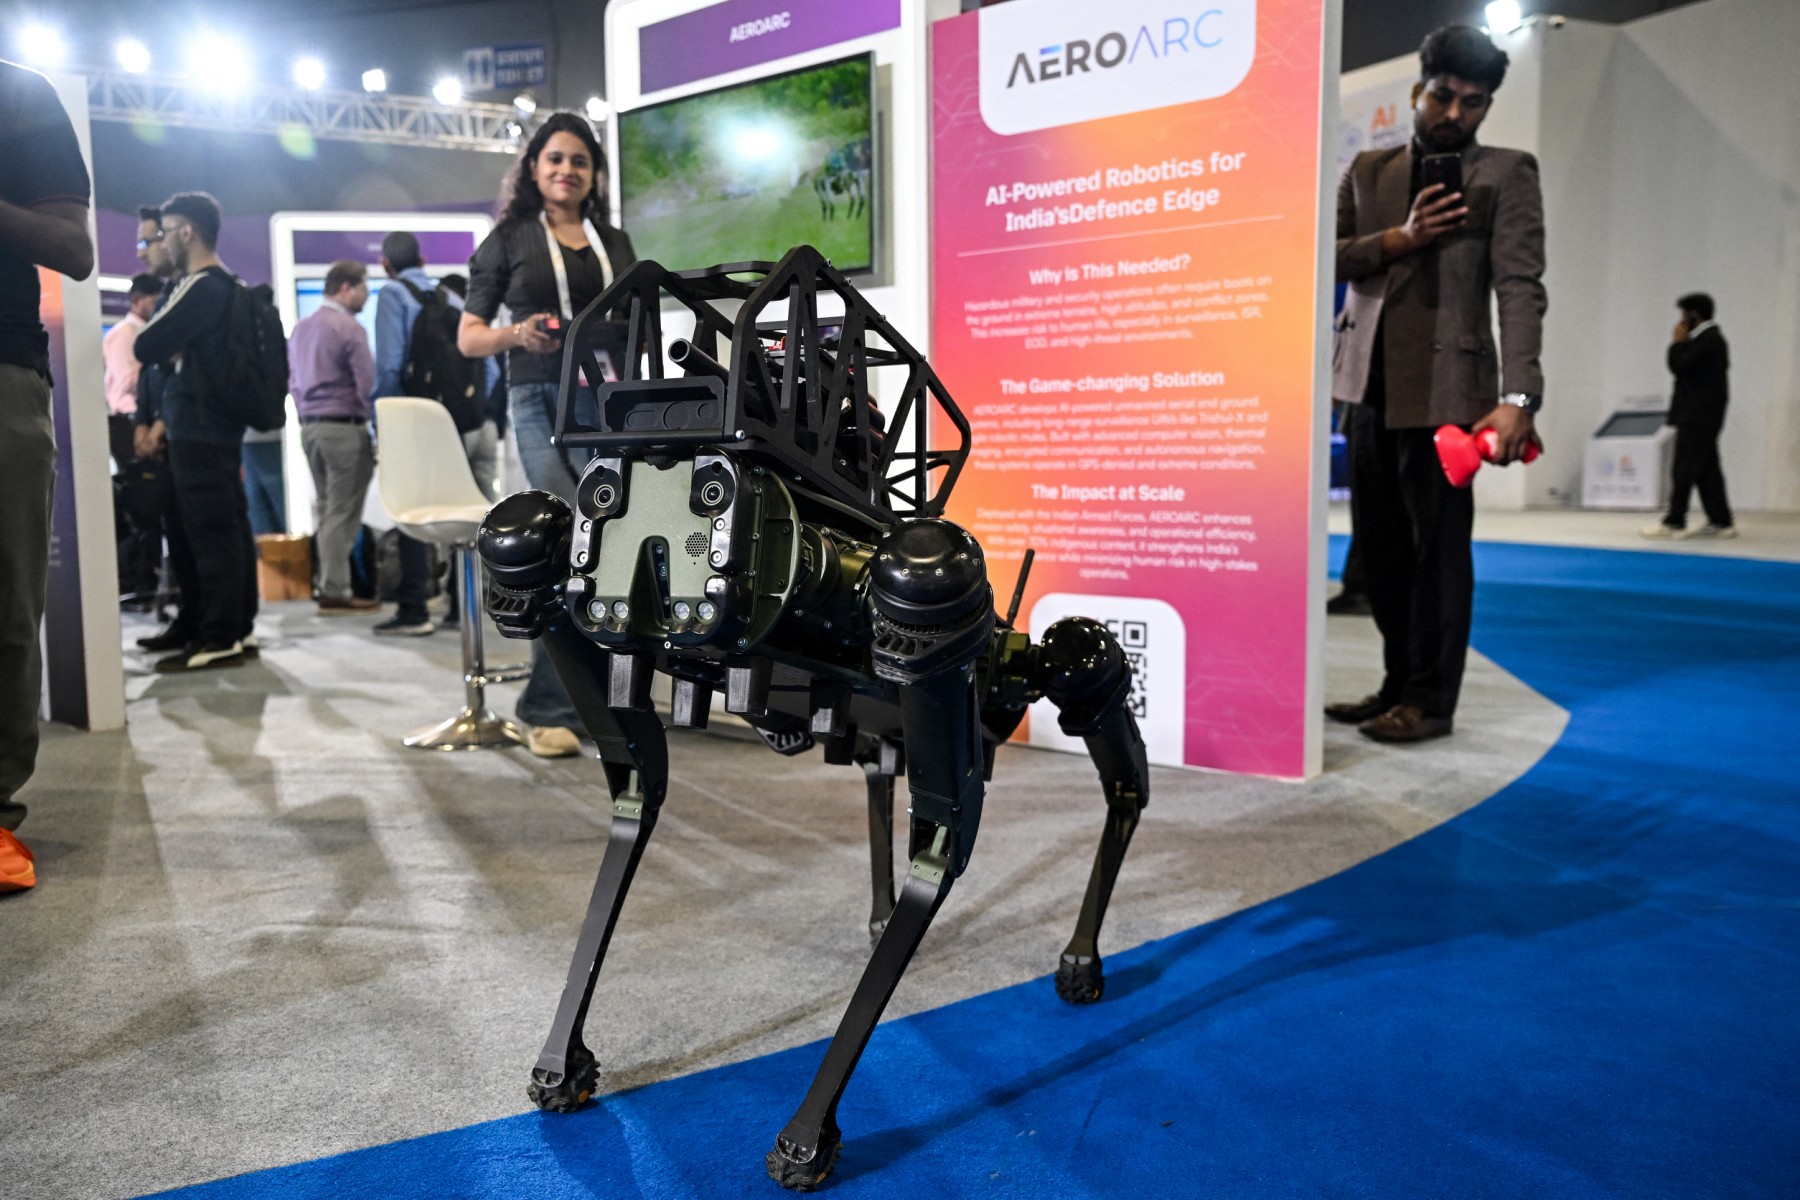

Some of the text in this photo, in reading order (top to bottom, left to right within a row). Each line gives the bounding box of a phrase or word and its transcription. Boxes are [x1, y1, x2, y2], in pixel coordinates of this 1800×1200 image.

[729, 11, 791, 43] AEROARC
[1006, 9, 1224, 89] AEROARC
[985, 151, 1246, 206] AI-Powered Robotics for
[1163, 186, 1220, 214] Edge
[1029, 253, 1191, 286] Why is This Needed?
[1000, 370, 1224, 395] The Game-changing Solution
[1031, 484, 1186, 502] The Impact at Scale
[1149, 511, 1201, 524] AEROARC
[1202, 512, 1253, 525] enhances
